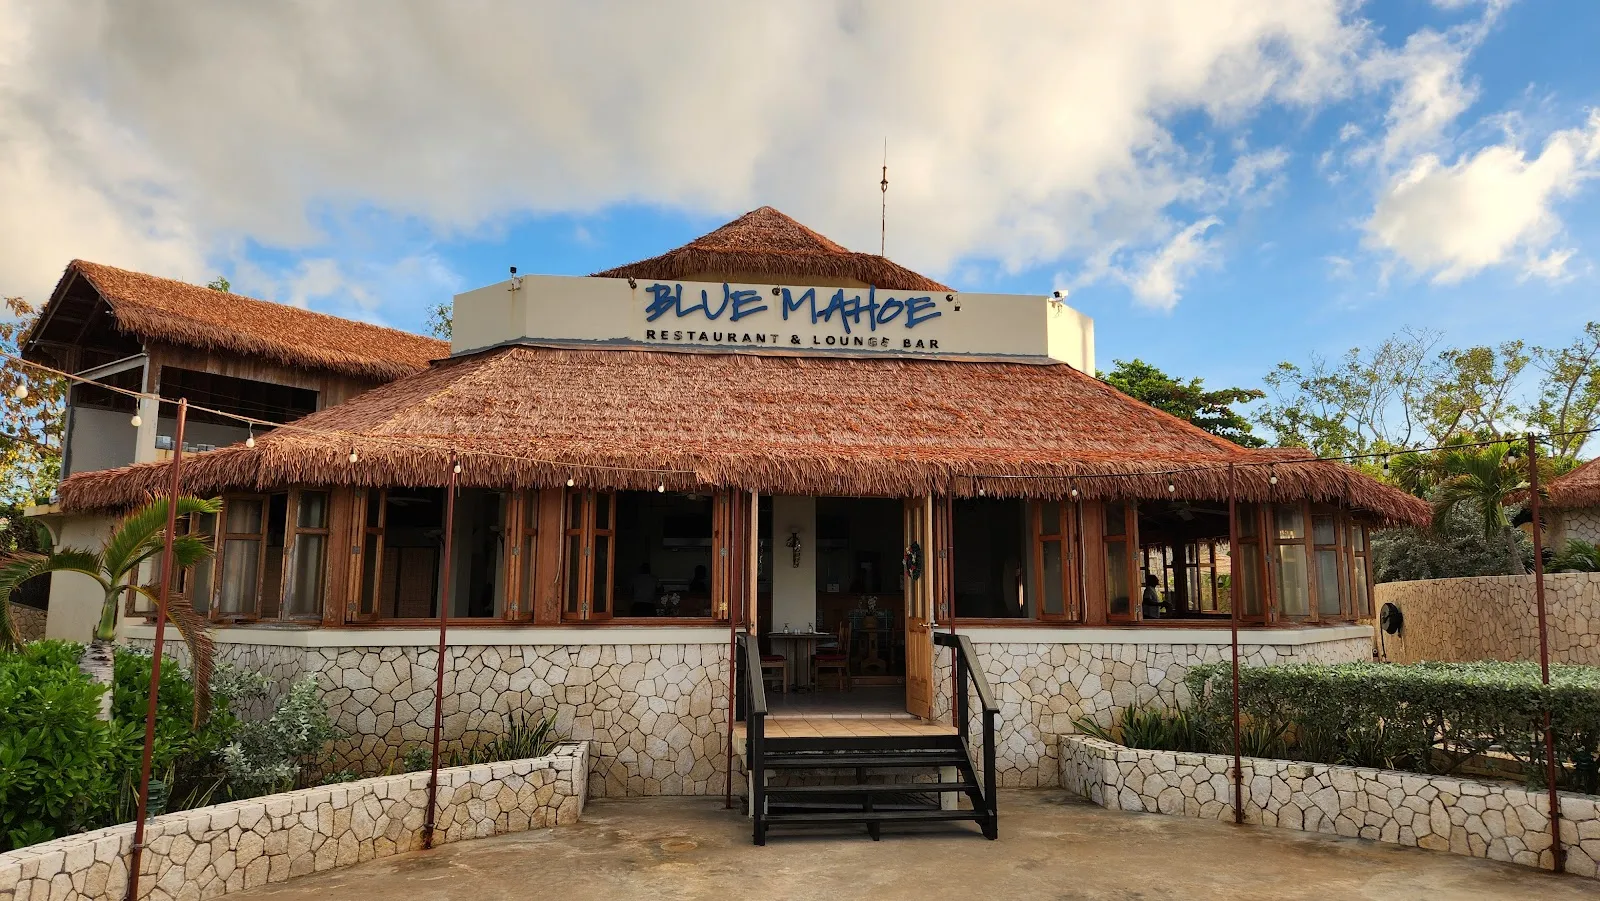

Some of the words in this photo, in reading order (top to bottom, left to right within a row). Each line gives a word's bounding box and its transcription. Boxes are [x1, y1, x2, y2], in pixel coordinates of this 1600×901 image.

[645, 282, 768, 322] BLUE
[781, 284, 942, 334] MAHOE
[646, 329, 779, 344] RESTAURANT
[790, 334, 801, 345] &
[813, 335, 890, 348] LOUNGE
[903, 338, 940, 349] BAR
